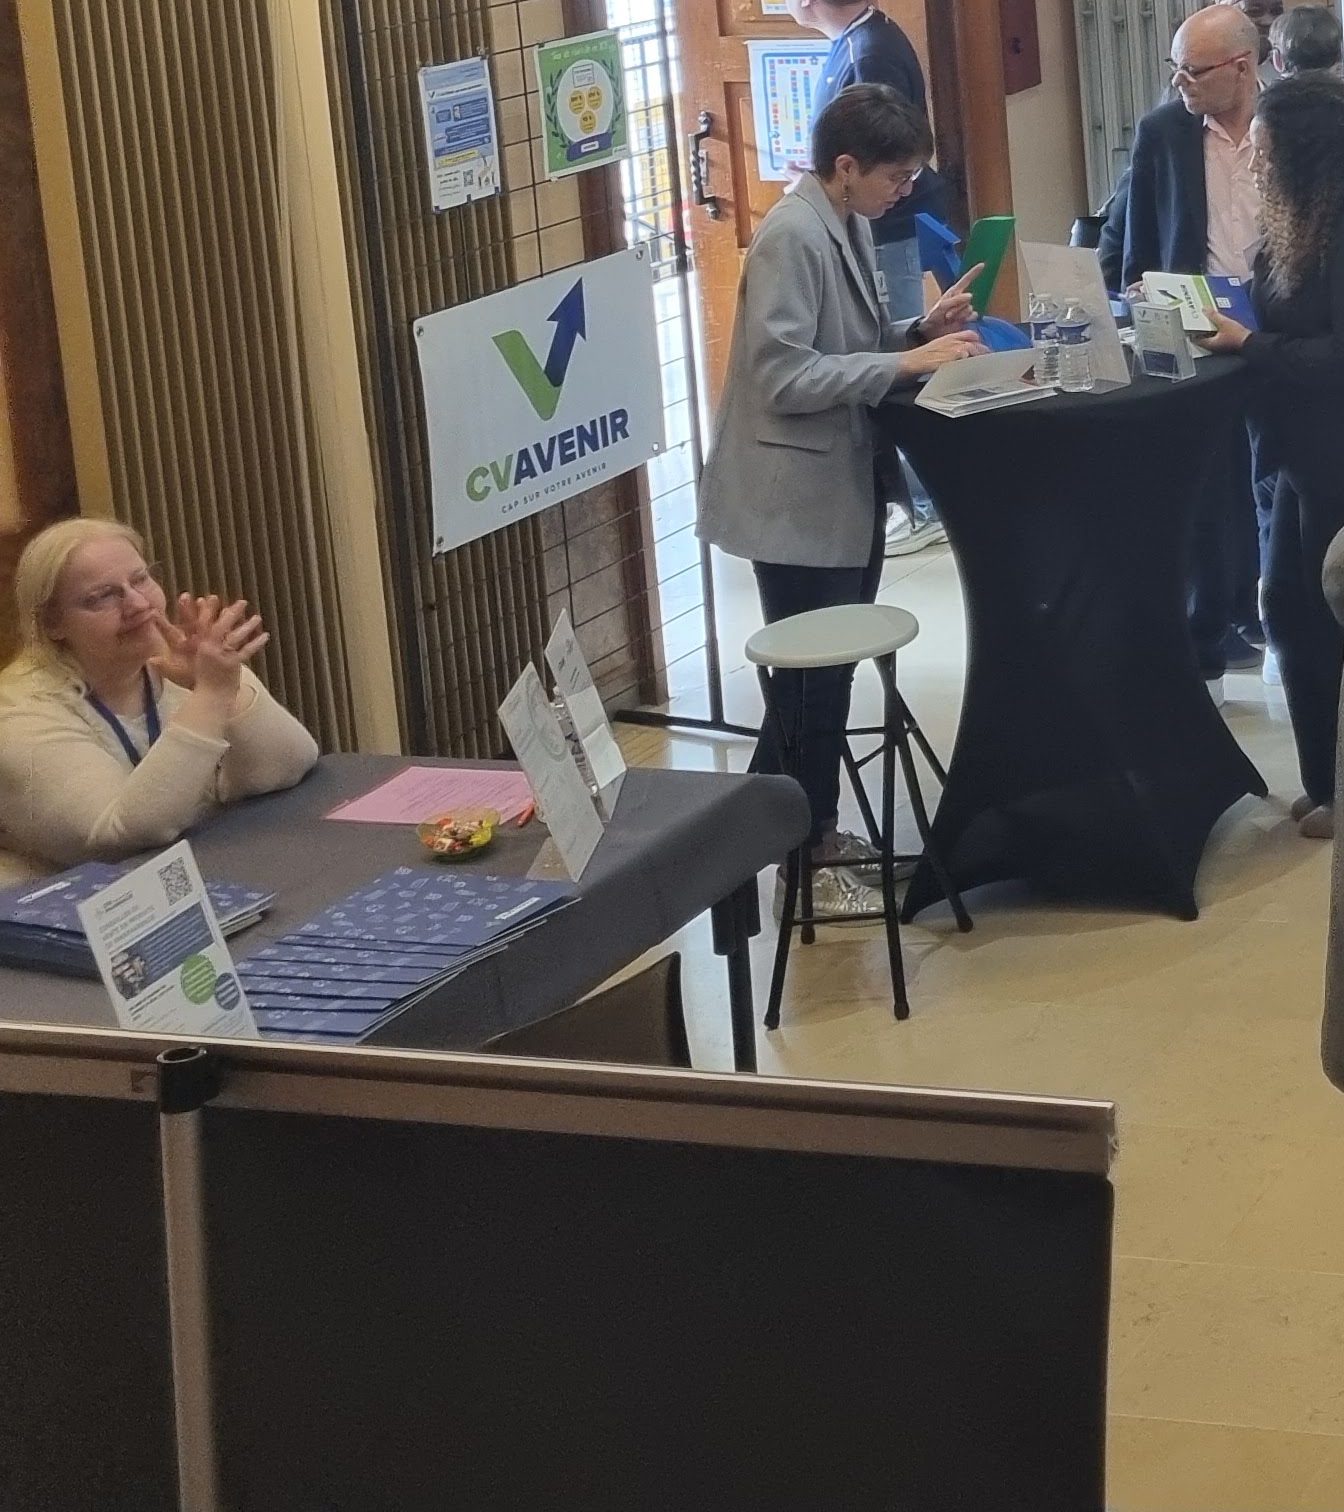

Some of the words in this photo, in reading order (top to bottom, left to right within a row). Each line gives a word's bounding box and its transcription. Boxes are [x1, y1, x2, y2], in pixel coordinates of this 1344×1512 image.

[466, 408, 630, 502] CVAVENIR
[502, 501, 520, 514] CAP
[523, 491, 541, 505] SUR
[544, 477, 572, 495] VOTRE
[576, 462, 607, 482] AVENIR
